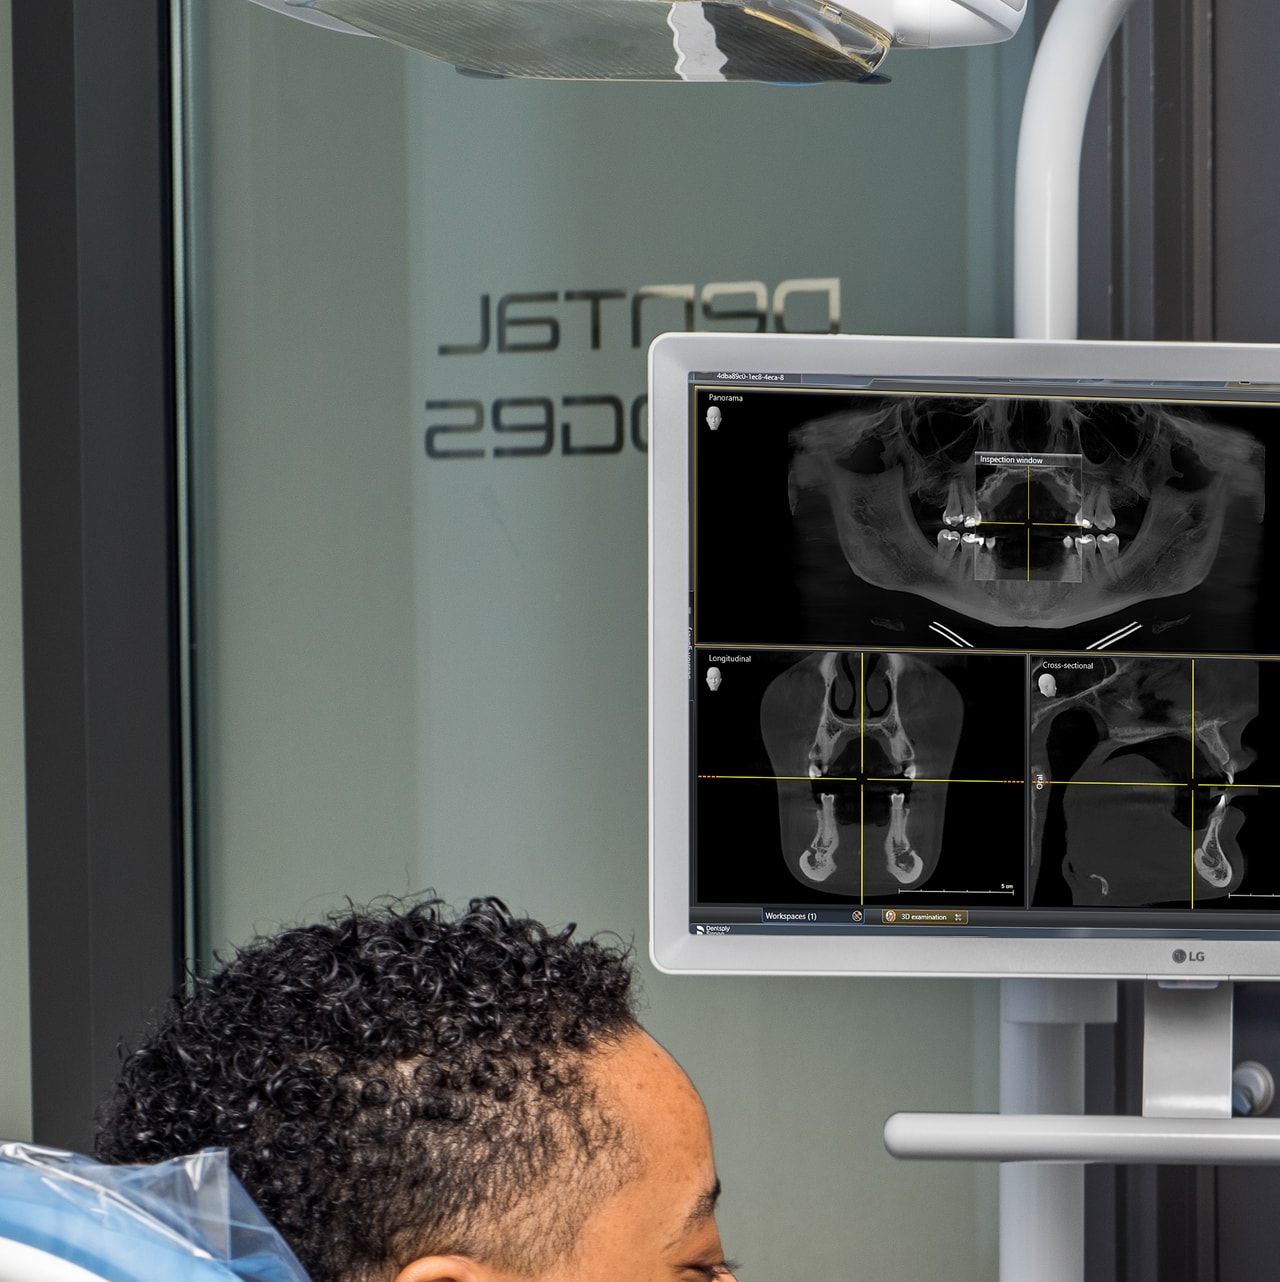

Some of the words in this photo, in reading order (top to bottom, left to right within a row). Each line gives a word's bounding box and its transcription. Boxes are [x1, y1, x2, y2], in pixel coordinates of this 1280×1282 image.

[708, 393, 744, 402] Panorama
[980, 455, 1015, 465] Inspection
[1016, 456, 1044, 464] window
[708, 654, 752, 664] Longitudinal
[1042, 661, 1094, 670] Cross-sectional
[1036, 774, 1044, 790] Oral
[765, 912, 806, 921] Workspaces
[807, 912, 817, 921] (1)
[706, 925, 730, 933] Dentsply
[1189, 951, 1205, 962] LG
